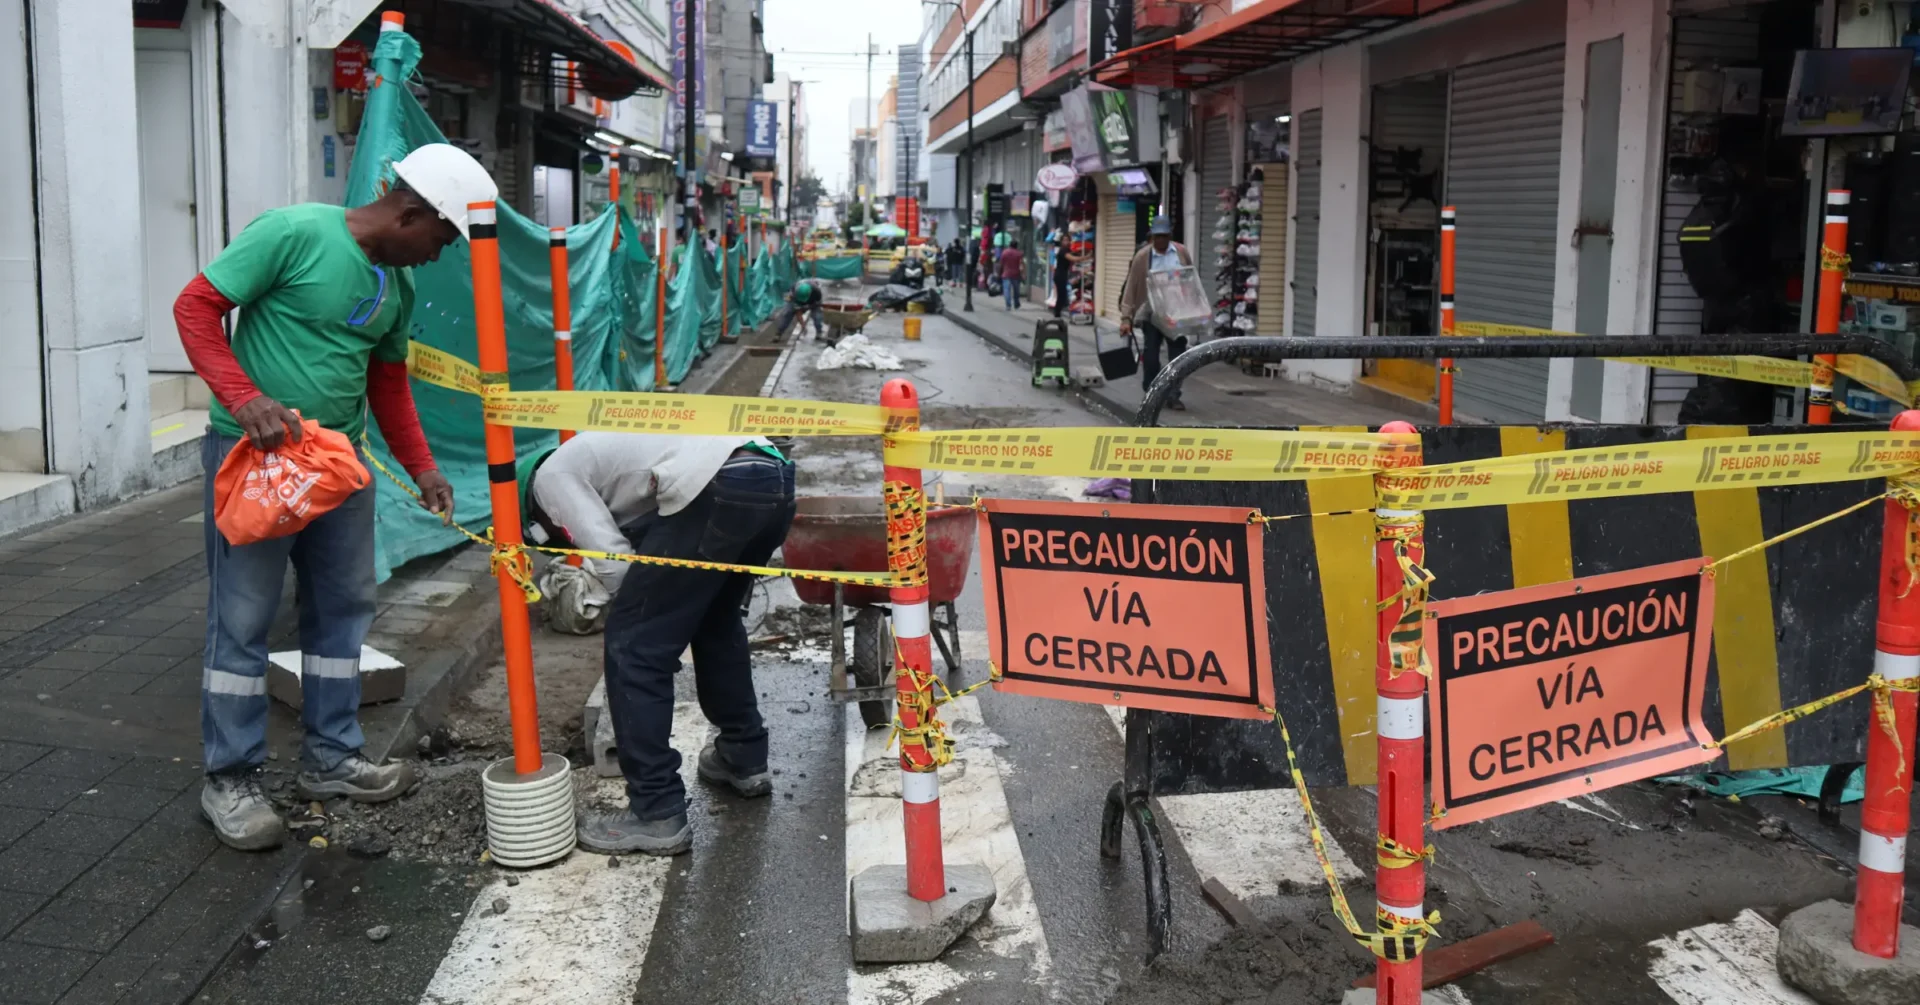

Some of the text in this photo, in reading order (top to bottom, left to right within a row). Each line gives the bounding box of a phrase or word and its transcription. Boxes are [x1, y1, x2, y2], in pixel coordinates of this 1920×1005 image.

[605, 407, 696, 420] PELIGRO NO PASE
[748, 414, 794, 425] PELIGRO
[797, 417, 814, 425] NO
[949, 444, 1053, 457] PELIGRO NO PASE
[1114, 447, 1233, 461] PELIGRO NO PASE
[1304, 452, 1368, 467] PELIGRO
[1373, 455, 1394, 467] NO
[1554, 460, 1663, 481] PELIGRO NO PASE
[1721, 452, 1821, 470] PELIGRO NO PASE
[1434, 475, 1456, 488] NO
[1459, 472, 1493, 486] PASE
[1001, 528, 1234, 576] PRECAUCIÓN
[1083, 581, 1151, 627] VÍA
[1453, 589, 1686, 670] PRECAUCIÓN
[1025, 633, 1227, 686] CERRADA
[1537, 662, 1604, 709] VÍA
[1469, 704, 1666, 781] CERRADA
